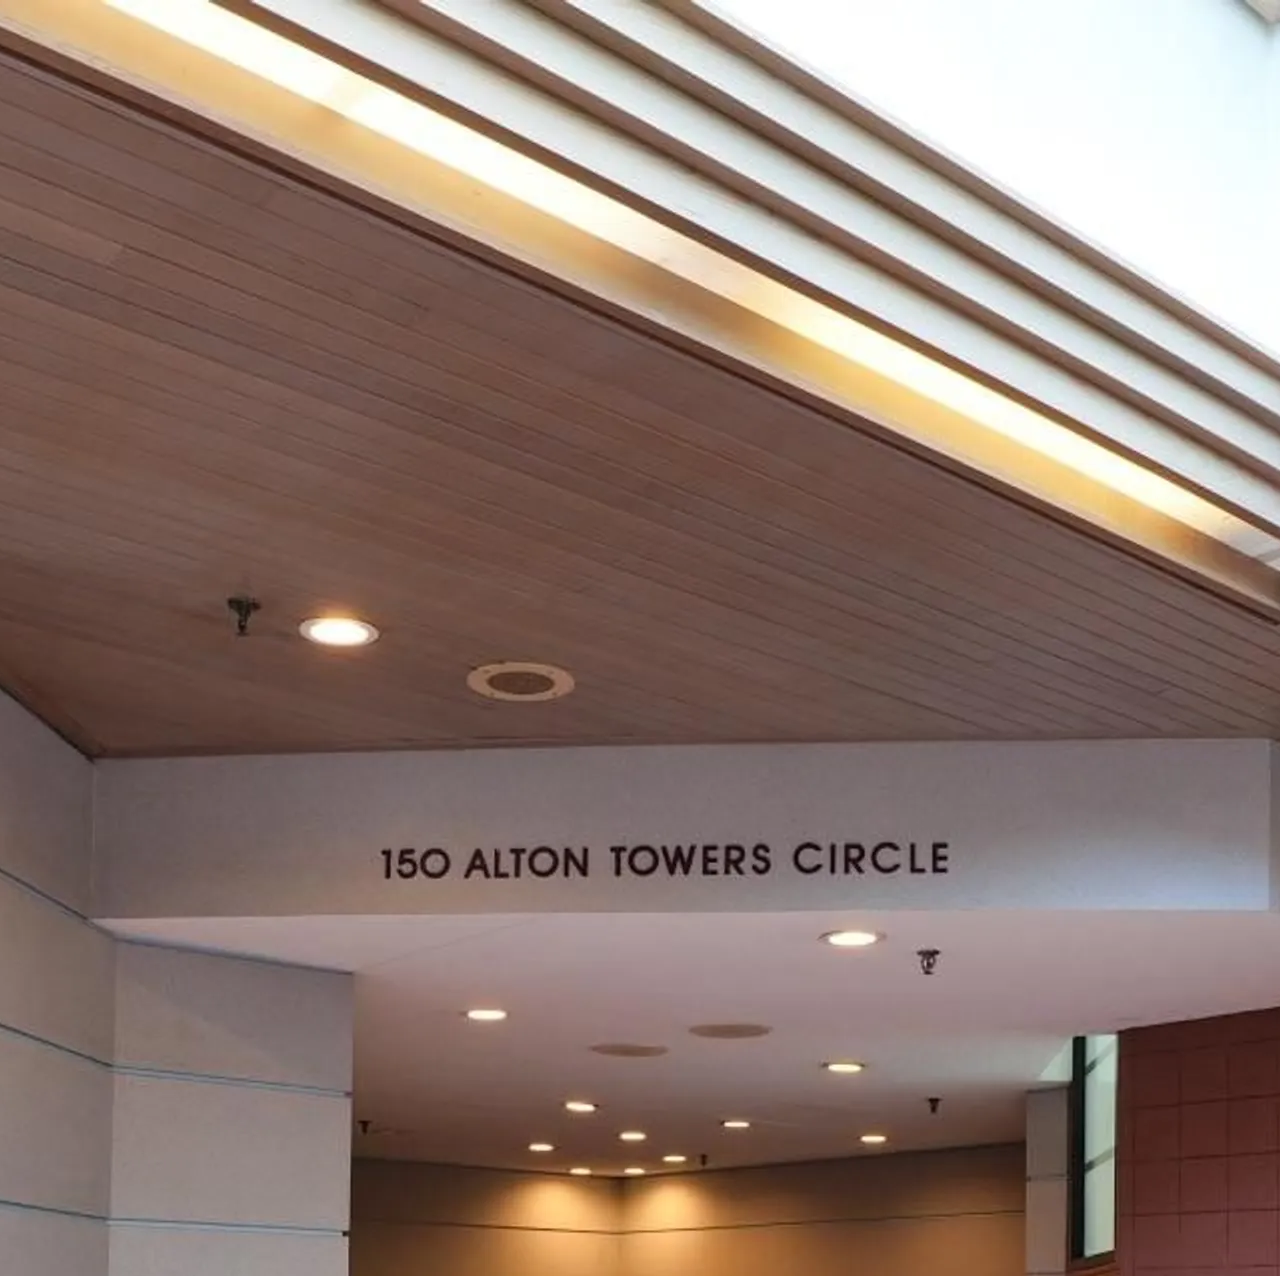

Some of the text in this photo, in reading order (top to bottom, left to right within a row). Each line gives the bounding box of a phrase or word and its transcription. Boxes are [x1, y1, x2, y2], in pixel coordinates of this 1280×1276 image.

[380, 841, 949, 879] 150 ALTON TOWERS CIRCLE
